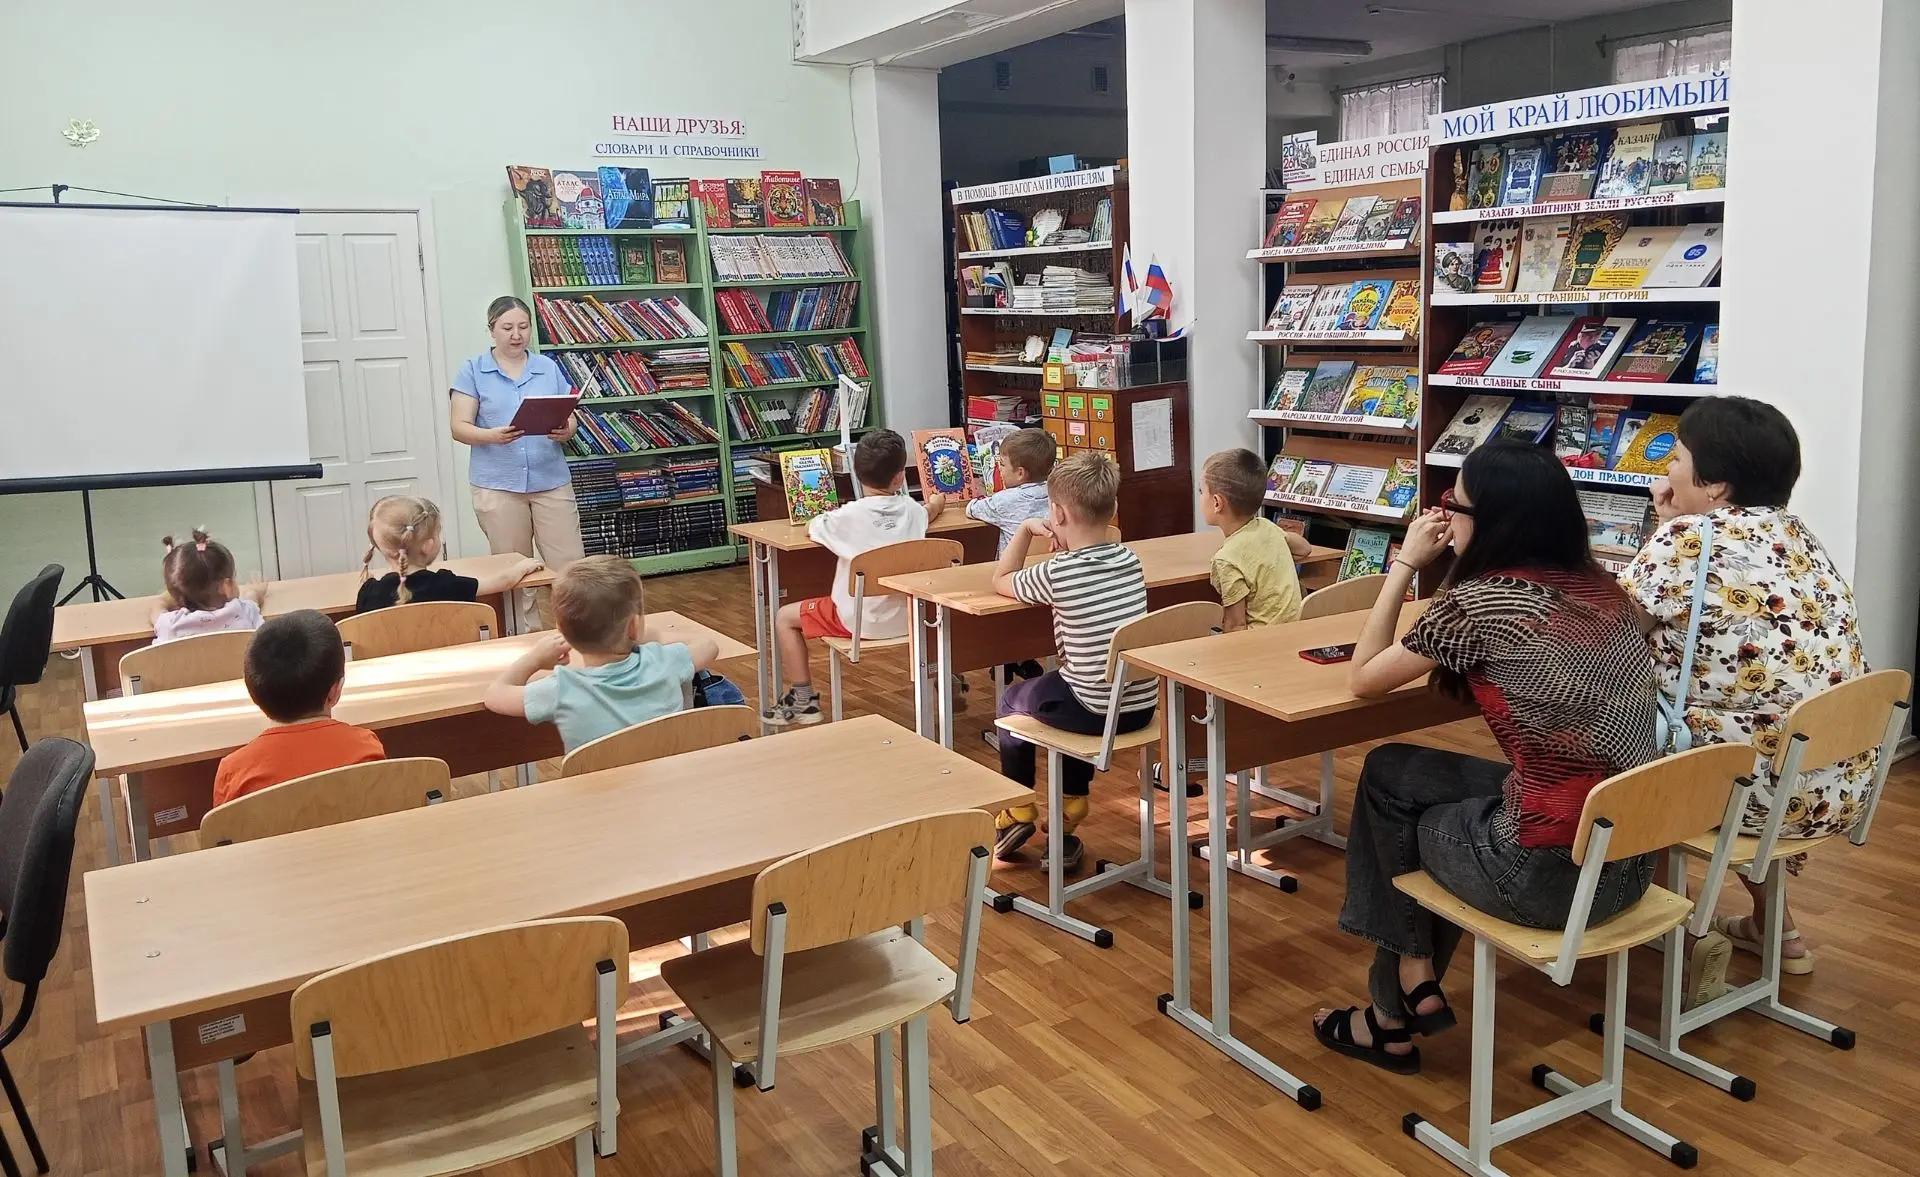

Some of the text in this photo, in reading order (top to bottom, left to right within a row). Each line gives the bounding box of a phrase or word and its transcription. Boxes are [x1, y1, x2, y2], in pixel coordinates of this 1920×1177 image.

[1442, 71, 1729, 139] МОЙ КРАЙ ЛЮБИМЫЙ
[613, 115, 745, 135] НАШИ ДРУЗЬЯ:
[595, 144, 759, 157] СЛОВАРИ И СПРАВОЧНИКИ
[1320, 135, 1430, 162] ЕДИНАЯ РОССИЯ
[1324, 160, 1424, 184] ЕДИНАЯ СЕМЬЯ
[957, 171, 1105, 201] В ПОМОЩЬ ПЕДАГОГАМ И РОДИТЕЛЯМ
[1479, 208, 1514, 218] КАЗАКИ
[1585, 200, 1619, 210] ЗЕМЛИ
[1621, 192, 1675, 206] РУССКОЙ
[1492, 291, 1649, 303] ЛИСТАЯ СТРАНИЦЫ ИСТОРИИ
[1456, 377, 1561, 389] ДОНА СЛАВНЫЕ СЫНЫ
[1281, 412, 1308, 420] НАРОДЫ
[1332, 415, 1364, 423] ДОНСКОЙ
[1572, 469, 1594, 480] ДОН
[1273, 492, 1296, 501] РАЗНЫЕ
[1300, 495, 1322, 505] ЯЗЫКИ
[1325, 499, 1346, 508] ДУША
[1351, 501, 1369, 511] ОДНА
